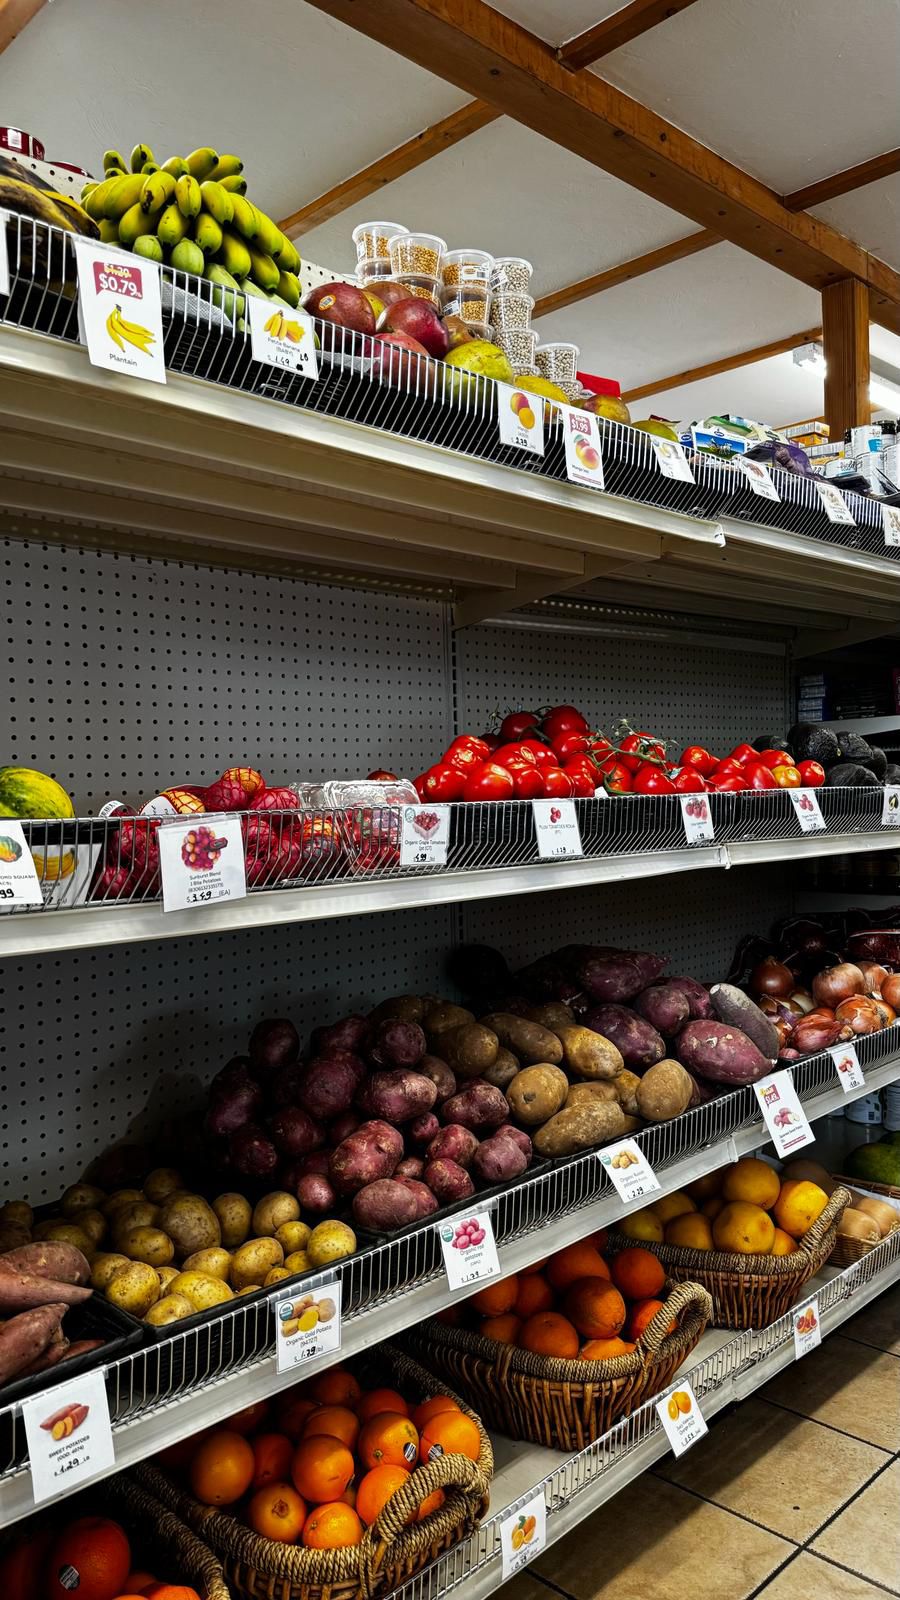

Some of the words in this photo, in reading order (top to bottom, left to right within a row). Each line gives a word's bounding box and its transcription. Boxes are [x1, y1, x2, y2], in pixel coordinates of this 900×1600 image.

[99, 273, 137, 296] $0.79
[109, 353, 138, 367] Plantain
[189, 872, 209, 880] Sunburst
[219, 888, 231, 896] (EA)
[286, 1335, 304, 1347] Organic
[304, 1329, 316, 1339] Gold
[315, 1325, 332, 1334] Potato
[48, 1444, 65, 1459] SWEET
[65, 1434, 90, 1450] POTATOES
